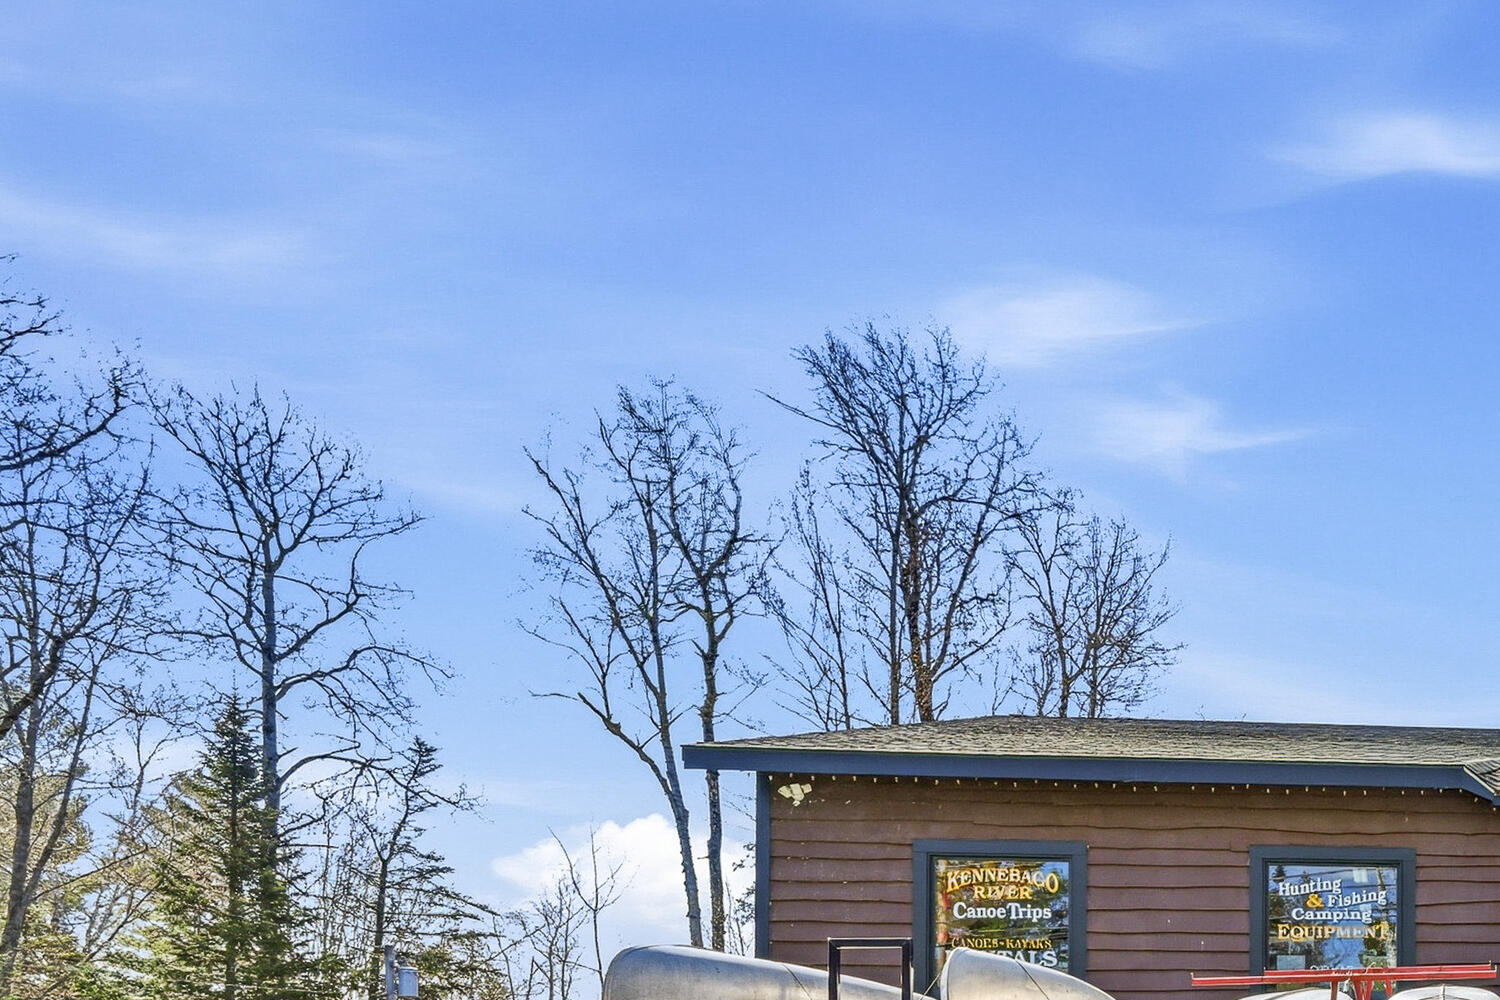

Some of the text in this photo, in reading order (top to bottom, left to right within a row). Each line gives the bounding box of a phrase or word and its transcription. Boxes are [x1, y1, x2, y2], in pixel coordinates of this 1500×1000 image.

[946, 868, 1059, 894] KENNEBAGO
[1278, 878, 1342, 896] Hunting
[973, 885, 1033, 900] RIVER
[1306, 889, 1387, 908] & Fishing
[953, 901, 1052, 922] Canoe Trips
[1291, 907, 1372, 924] Camping
[1276, 921, 1389, 942] EQUIPMENT
